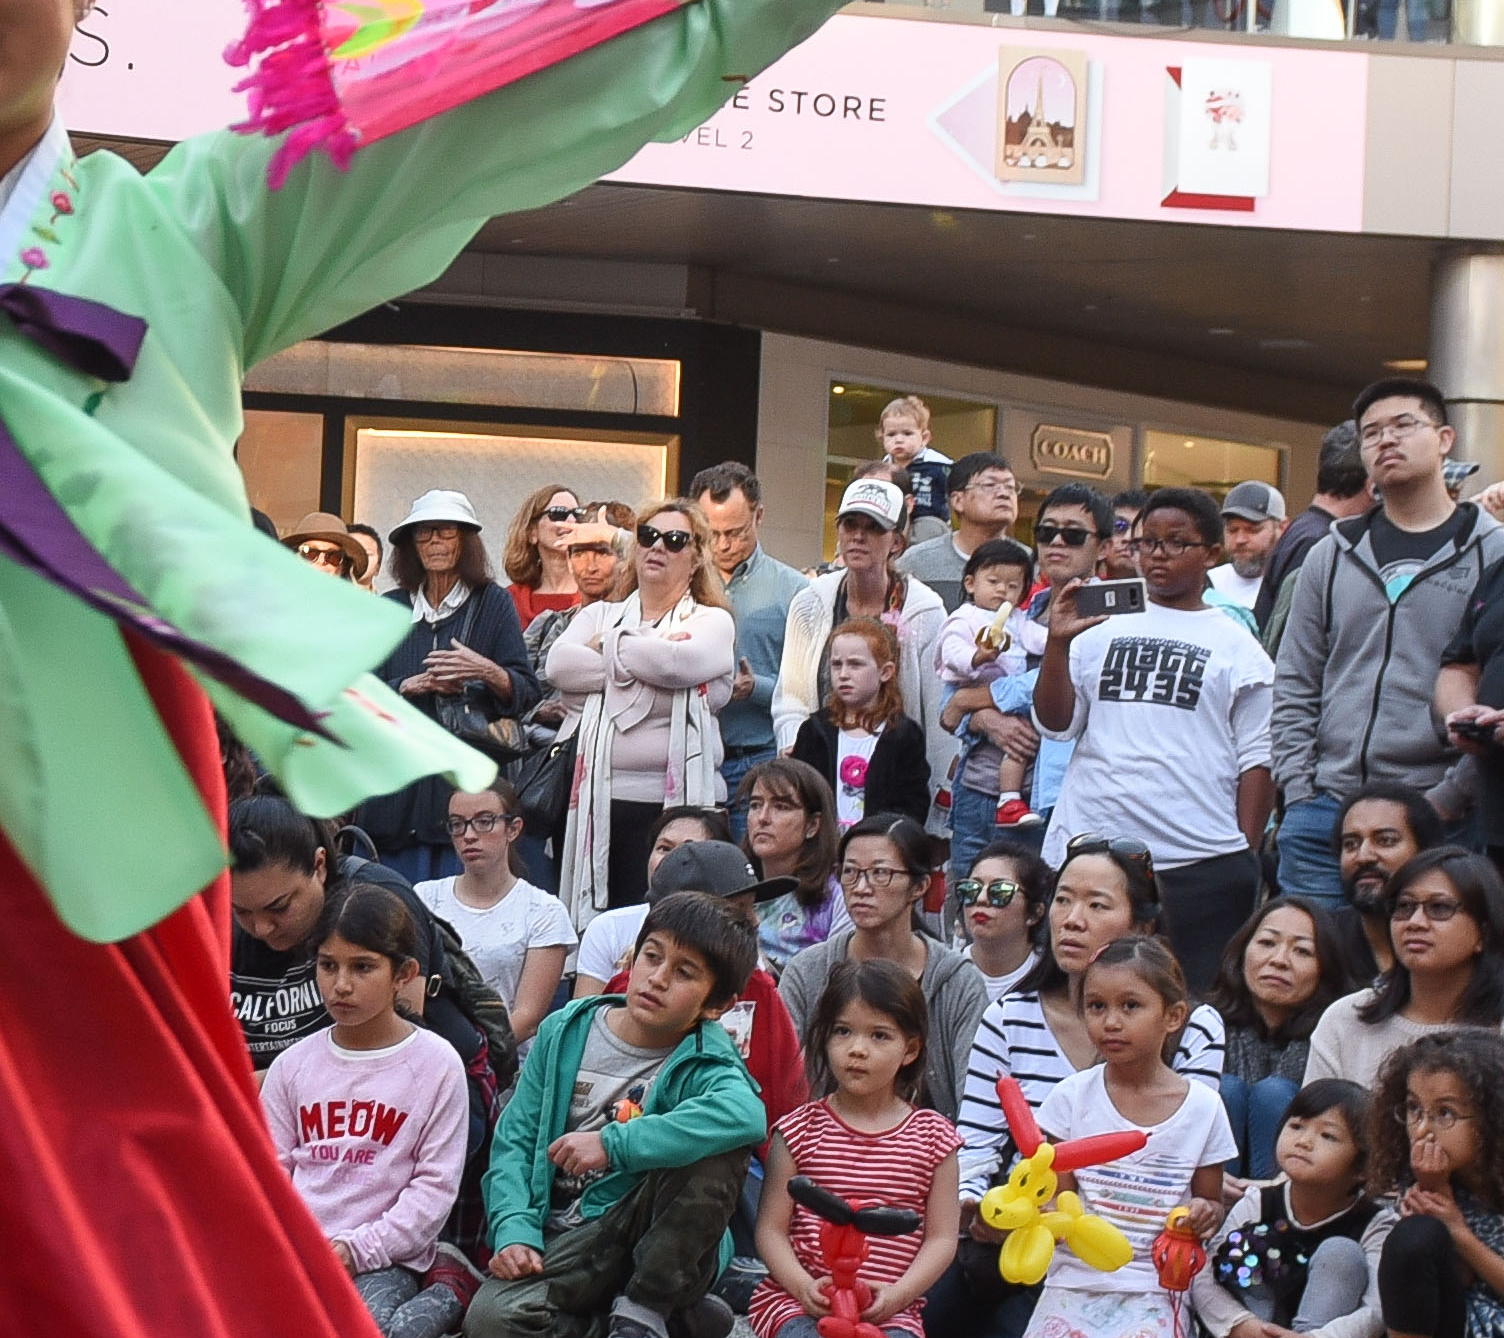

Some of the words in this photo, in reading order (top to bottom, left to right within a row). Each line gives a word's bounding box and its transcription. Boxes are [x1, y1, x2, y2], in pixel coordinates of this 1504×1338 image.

[768, 88, 887, 122] STORE
[741, 130, 754, 150] 2
[1039, 439, 1107, 465] COACH
[1099, 668, 1204, 709] 2435
[264, 1018, 297, 1034] FOCUS
[300, 1098, 409, 1147] MEOW
[310, 1144, 339, 1161] YOU
[342, 1147, 377, 1165] ARE
